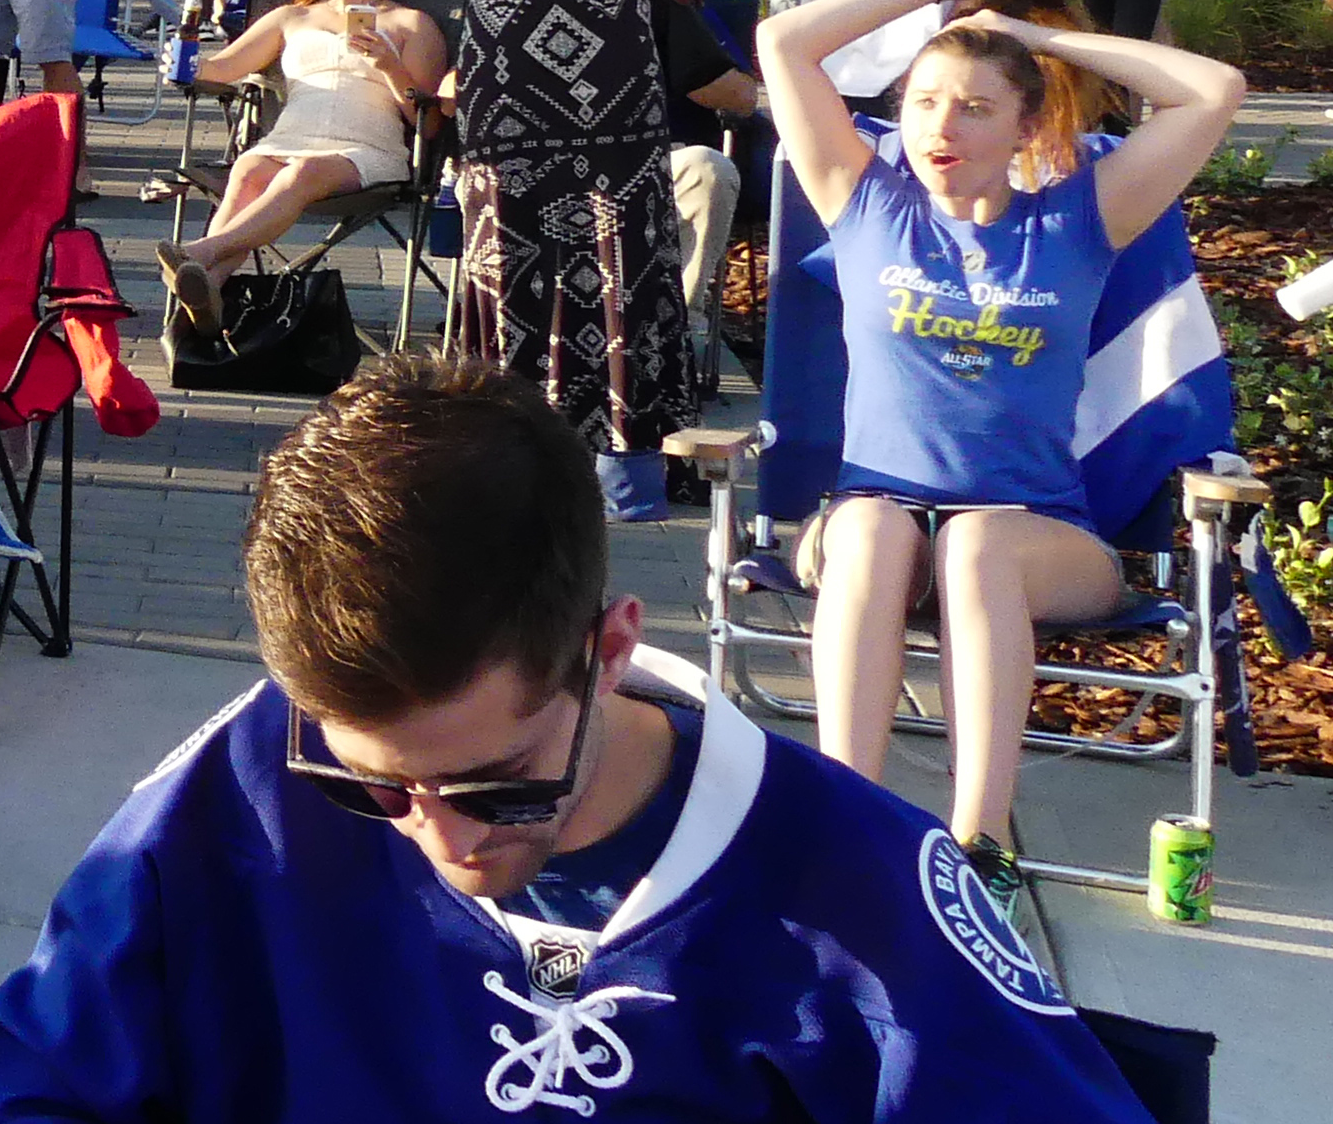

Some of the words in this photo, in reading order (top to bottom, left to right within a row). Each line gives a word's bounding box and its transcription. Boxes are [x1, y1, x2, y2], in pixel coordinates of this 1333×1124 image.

[879, 264, 968, 302] Atlantic
[969, 282, 1059, 307] Division
[888, 288, 1045, 367] Hockey
[934, 846, 957, 895] BAY
[538, 955, 577, 986] NHL
[945, 902, 1025, 992] TAMPA
